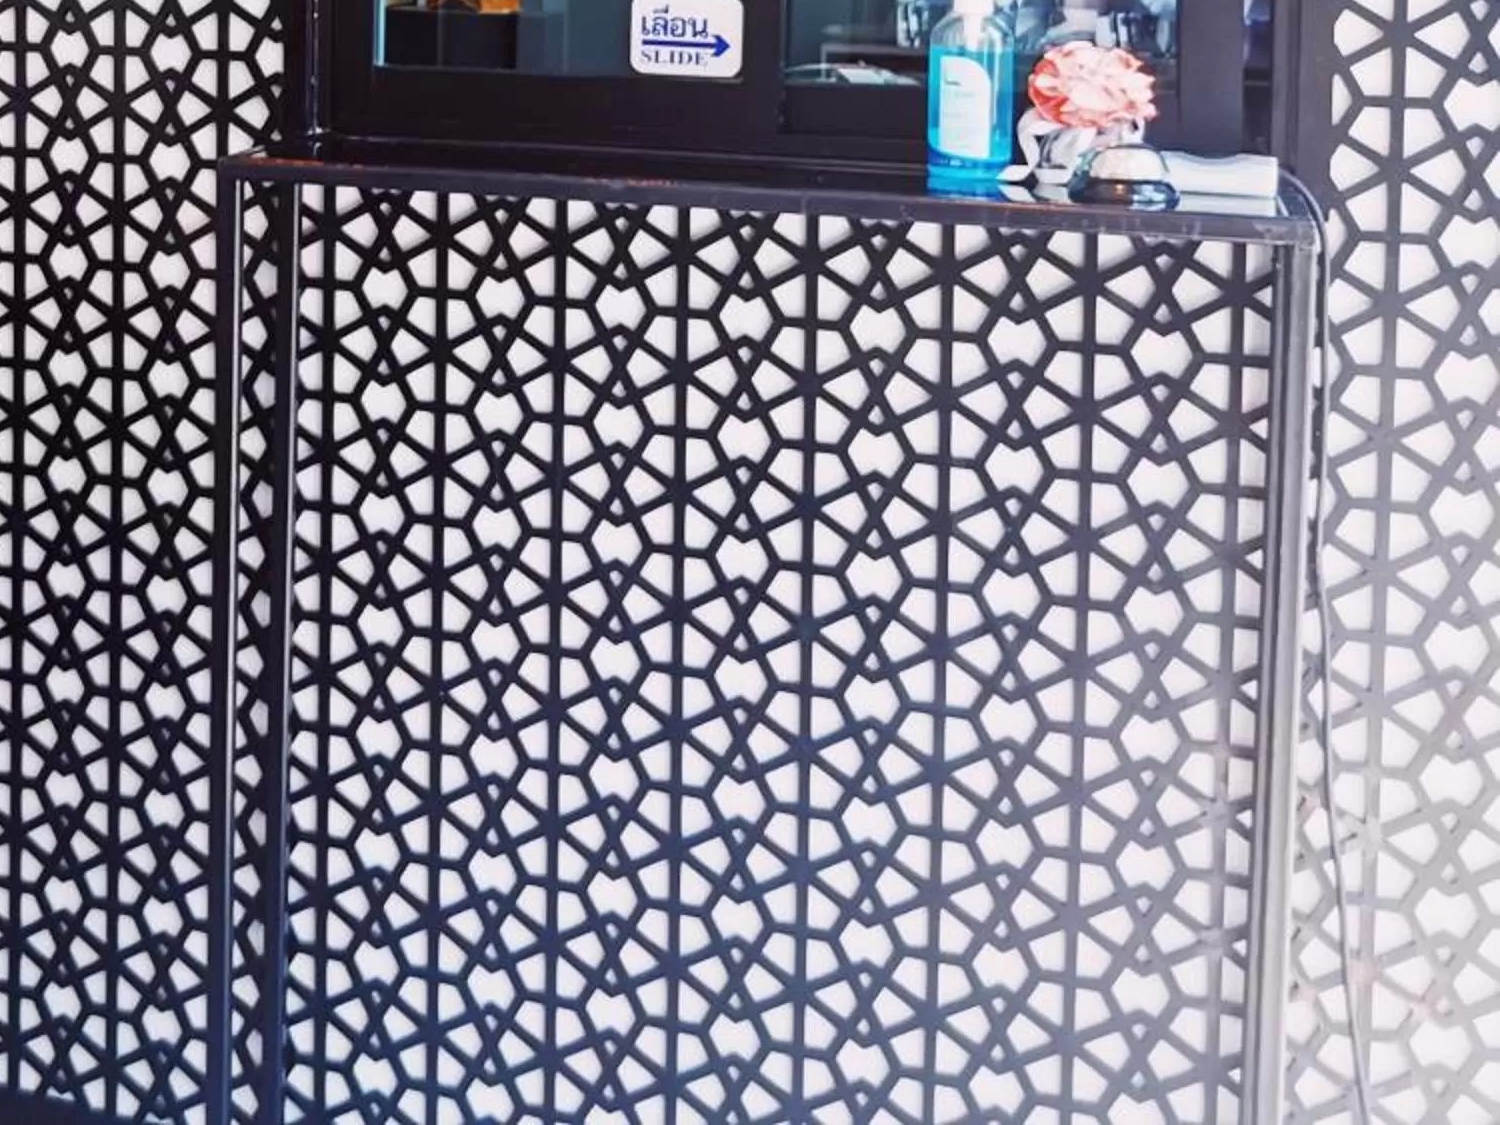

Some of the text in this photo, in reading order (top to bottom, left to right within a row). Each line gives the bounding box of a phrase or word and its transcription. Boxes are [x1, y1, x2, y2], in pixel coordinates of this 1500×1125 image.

[641, 3, 708, 38] เลื่อน
[640, 50, 708, 66] SLIDE
